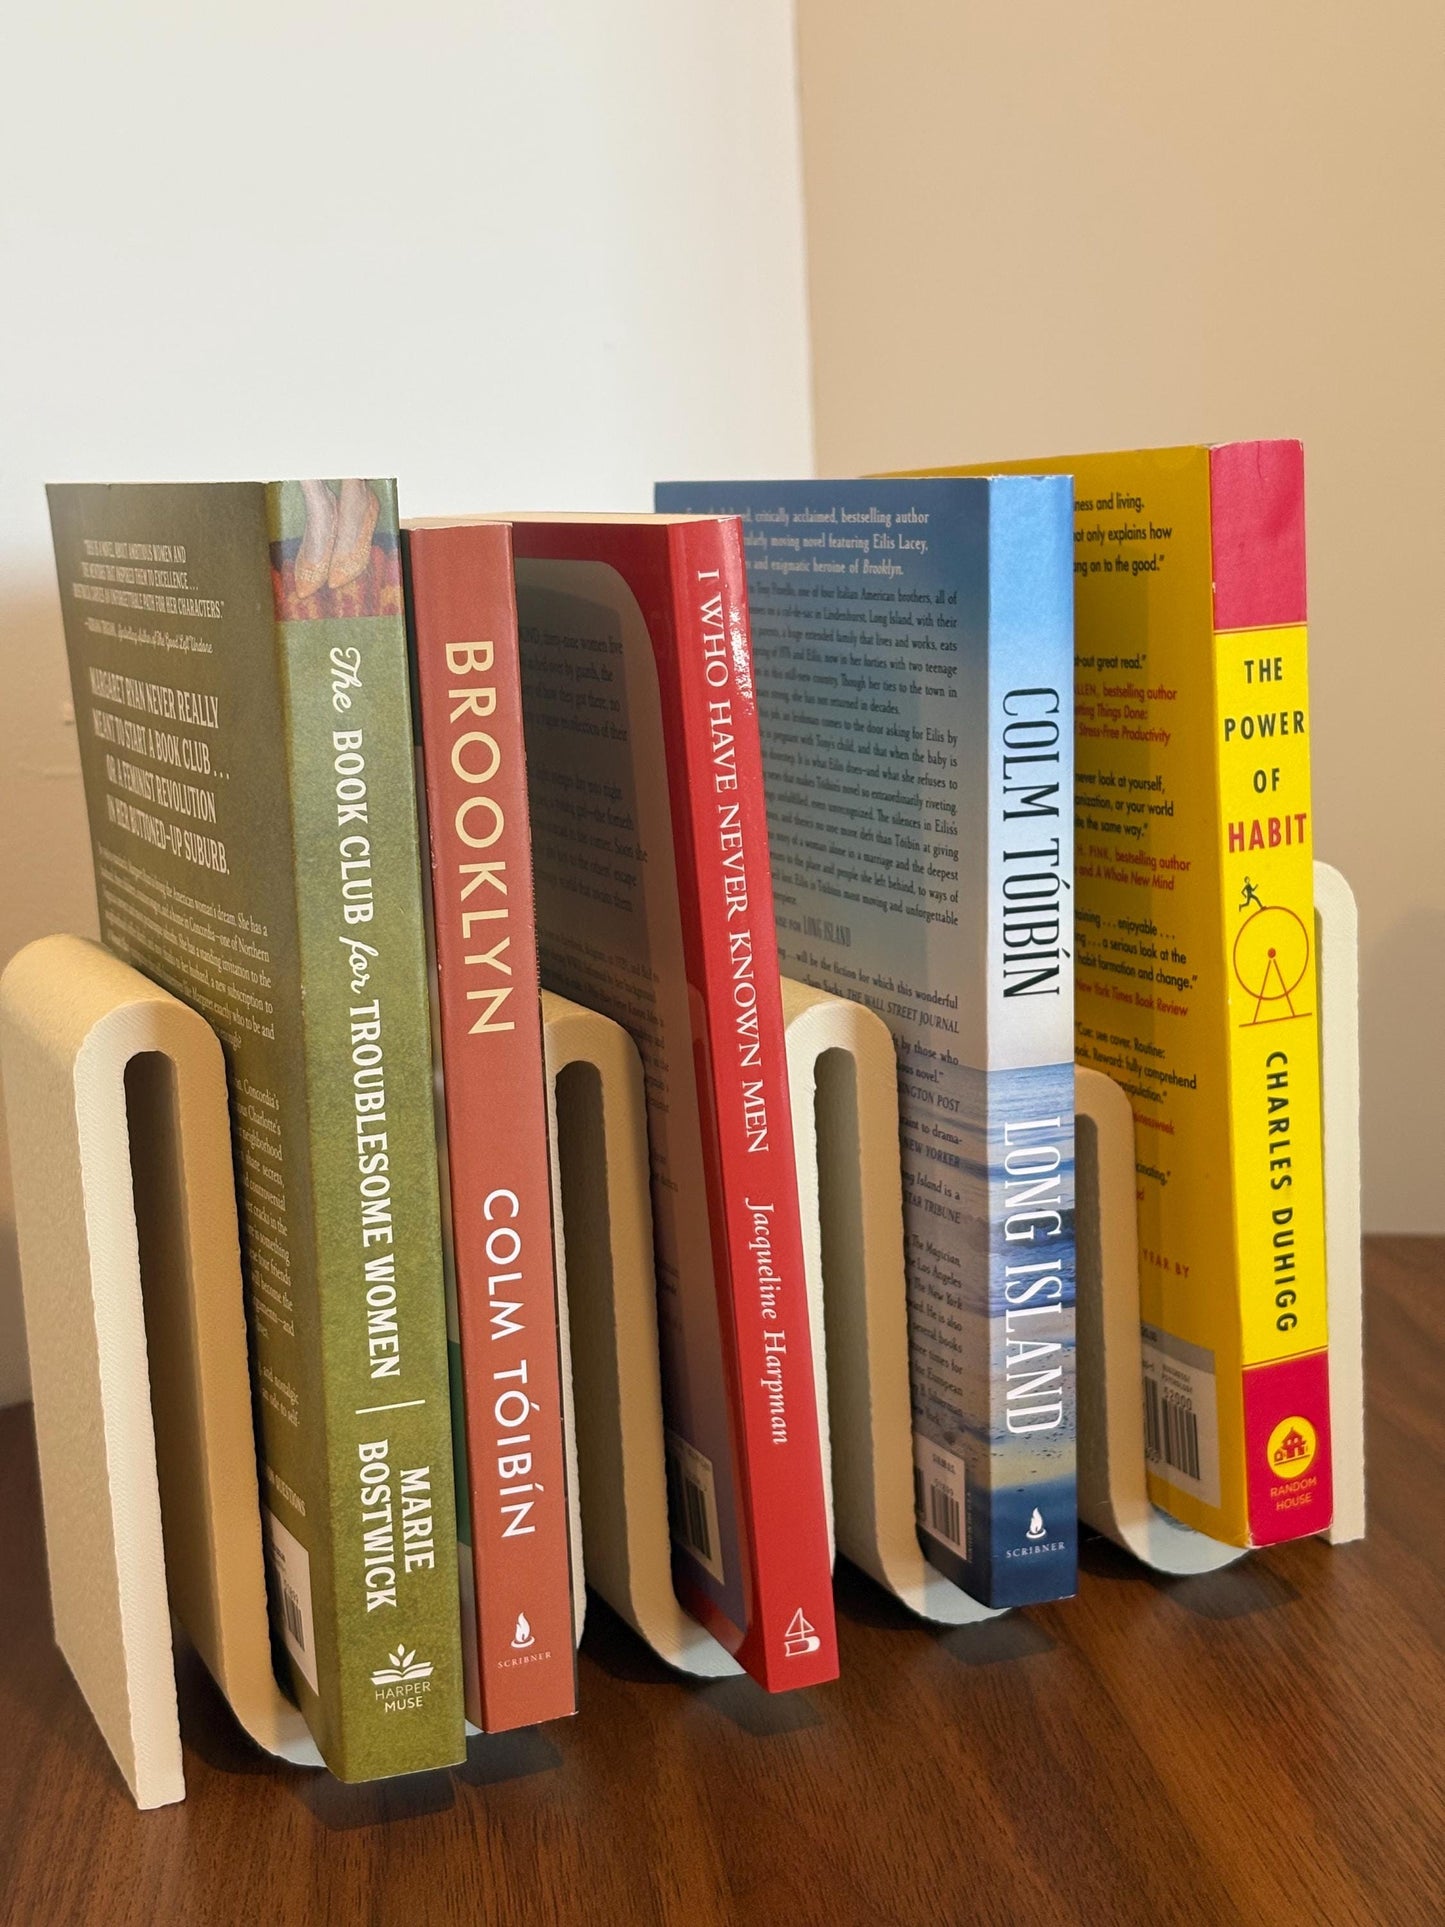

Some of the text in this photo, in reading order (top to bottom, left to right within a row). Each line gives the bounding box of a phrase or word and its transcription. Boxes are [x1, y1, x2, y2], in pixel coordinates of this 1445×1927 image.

[1096, 492, 1145, 513] and living.
[841, 506, 930, 528] bestselling author
[803, 531, 825, 548] novel
[829, 532, 869, 554] featuring
[873, 532, 896, 550] Eilis
[1086, 521, 1173, 546] only explains how
[812, 556, 846, 574] heroine
[1103, 558, 1113, 572] to
[1115, 554, 1129, 572] the
[917, 612, 934, 627] with
[937, 613, 957, 628] their
[895, 634, 958, 652] and eats
[909, 661, 958, 679] two teenage
[1244, 656, 1283, 684] THE
[909, 680, 945, 697] the town
[1102, 681, 1178, 703] bestselling author
[146, 682, 176, 720] NEVER
[177, 689, 219, 729] REALLY
[1097, 703, 1122, 722] Things
[886, 723, 958, 748] asking Eilis by
[1121, 725, 1171, 747] Productivity
[1224, 710, 1305, 742] POWER
[126, 720, 147, 756] START
[148, 726, 154, 757] A
[155, 729, 182, 767] BOOK
[183, 738, 211, 775] CLUB
[889, 745, 947, 769] when the baby
[122, 759, 155, 802] FEMINIST
[155, 773, 217, 824] REVOLUTION
[917, 772, 947, 788] refuses
[1098, 771, 1165, 794] look yourself,
[1253, 767, 1280, 793] OF
[892, 812, 921, 830] silences
[1126, 800, 1174, 817] your world
[130, 804, 183, 857] BUTTONED-UP
[184, 830, 230, 875] SUBURB.
[445, 640, 516, 1035] BROOKLYN
[1100, 822, 1121, 833] same
[1228, 812, 1307, 853] HABIT
[876, 830, 959, 862] than giving
[1002, 686, 1071, 999] COLM TÓIBÍN
[697, 568, 769, 1154] I WHO HAVE NEVER KNOWN MEN
[895, 857, 958, 882] and the deepest
[1115, 846, 1191, 871] bestselling author
[1103, 865, 1175, 891] Whole New Mind
[929, 889, 947, 903] ways
[889, 899, 958, 926] and unforgettable
[824, 919, 851, 947] ISLAND
[1118, 916, 1158, 936] enjoyable
[1109, 937, 1187, 964] serious look at the
[259, 969, 272, 988] the
[1097, 953, 1137, 977] formation
[1137, 966, 1154, 981] and
[872, 973, 958, 1009] which this wonderful
[1093, 982, 1189, 1017] York Times Book Review
[265, 1001, 273, 1014] to
[329, 646, 400, 1380] The BOOK CLUB for TROUBLESOME WOMEN
[864, 993, 960, 1034] WALL STREET JOURNAL
[262, 1024, 275, 1040] and
[914, 1040, 959, 1066] those who
[1125, 1054, 1197, 1090] fully comprehend
[937, 1094, 961, 1112] POST
[932, 1123, 963, 1145] drama-
[925, 1144, 961, 1168] YORKER
[917, 1172, 942, 1193] Island
[1264, 1050, 1298, 1333] CHARLES DUHIGG
[925, 1198, 961, 1224] TRIBUNE
[1003, 1115, 1063, 1435] LONG ISLAND
[745, 1197, 789, 1446] Jacqueline Harpman
[483, 1188, 544, 1539] COLM TÓIBÍN
[1269, 1476, 1318, 1498] RANDOM
[1275, 1491, 1313, 1512] HOUSE
[358, 1438, 397, 1613] BOSTWICK
[400, 1465, 436, 1573] MARIE
[1006, 1541, 1066, 1558] SCRIBNER
[497, 1650, 553, 1670] SCRIBNER
[375, 1680, 431, 1701] HARPER
[384, 1695, 423, 1713] MUSE
